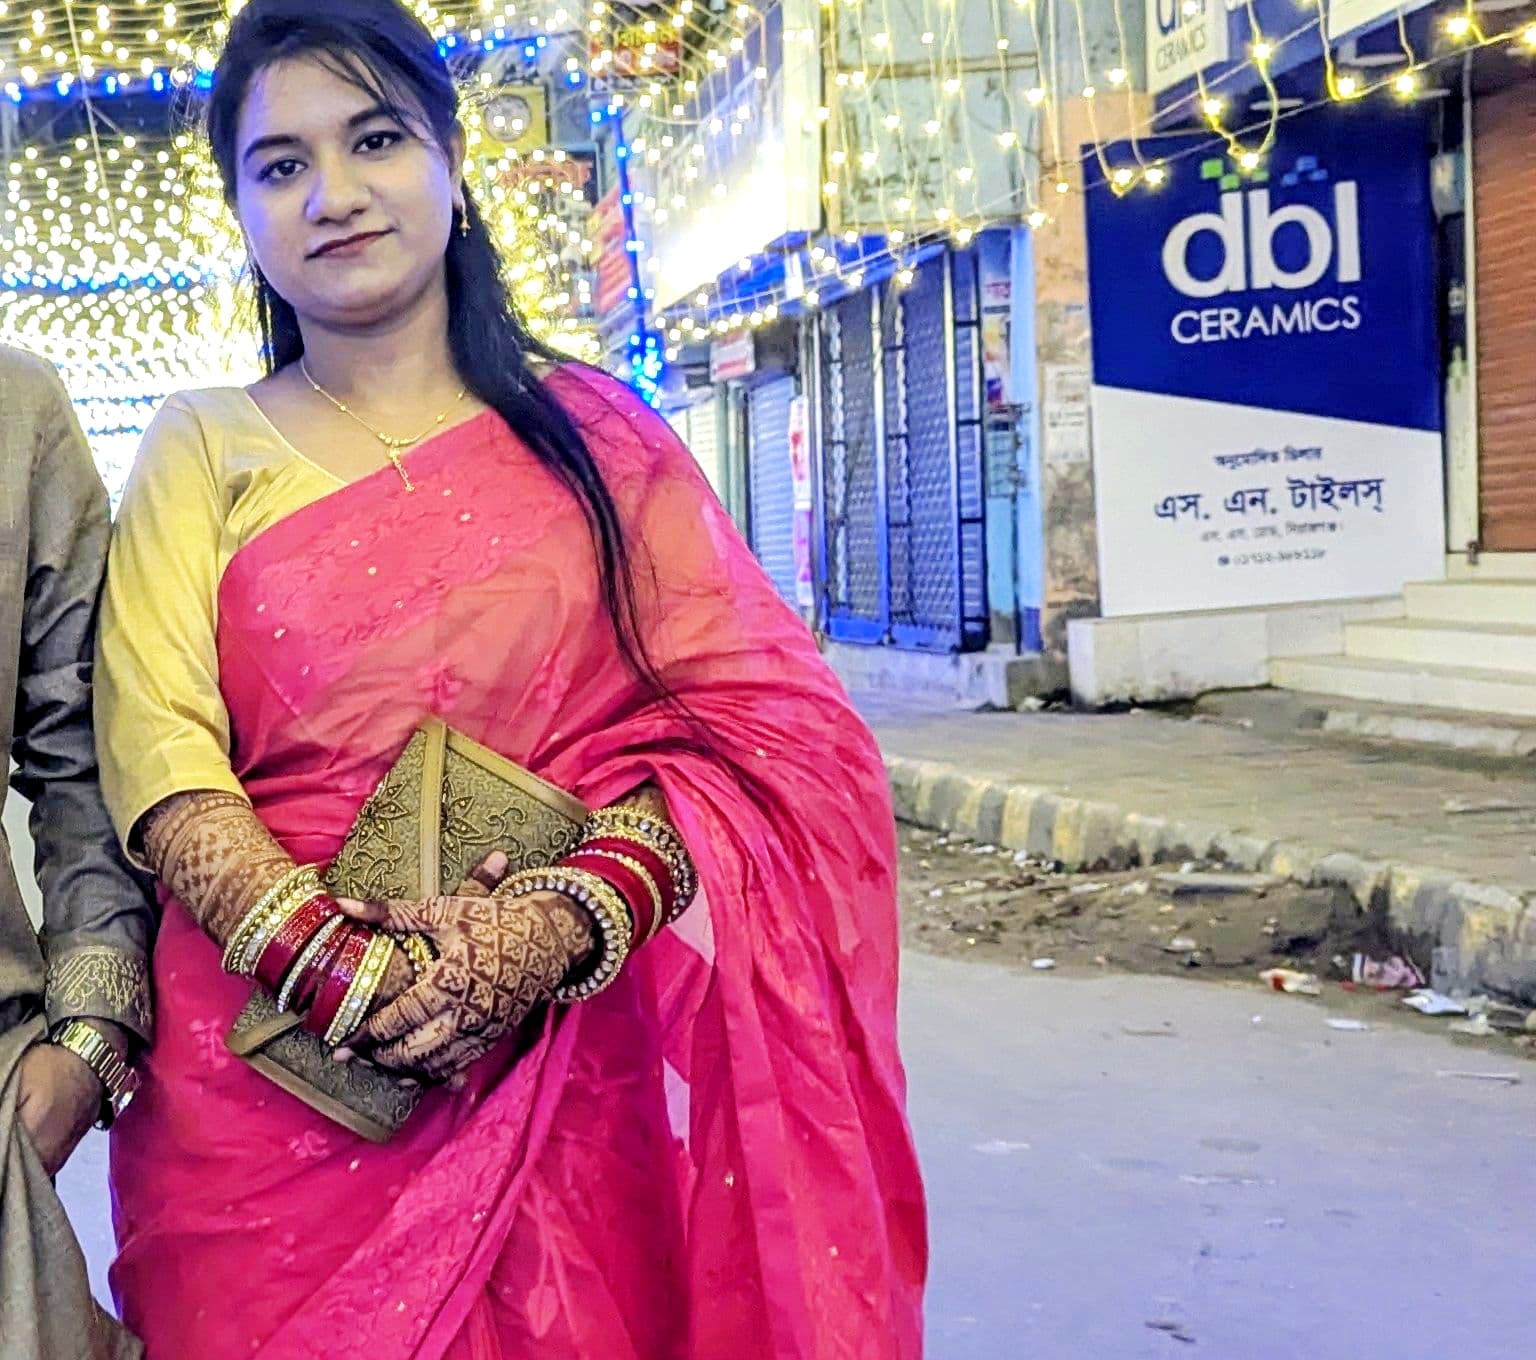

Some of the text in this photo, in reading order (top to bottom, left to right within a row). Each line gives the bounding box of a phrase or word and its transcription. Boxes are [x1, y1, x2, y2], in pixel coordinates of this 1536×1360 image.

[1162, 180, 1361, 298] dbl
[1170, 295, 1361, 344] CERAMICS
[1154, 475, 1385, 520] এস. এন. টাইলস্
